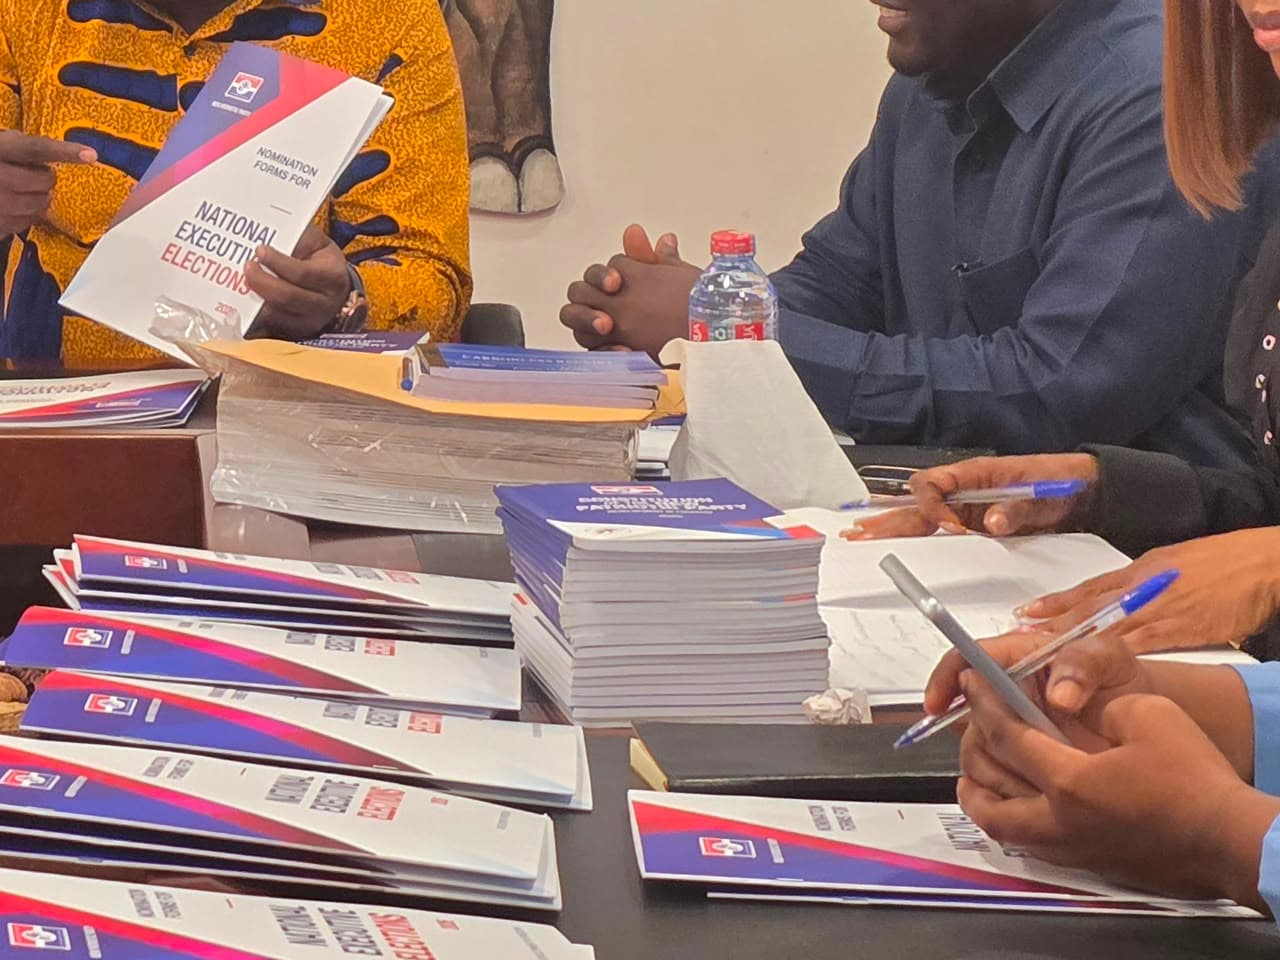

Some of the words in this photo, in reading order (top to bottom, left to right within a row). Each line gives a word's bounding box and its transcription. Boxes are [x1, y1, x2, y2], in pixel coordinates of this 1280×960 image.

[253, 159, 289, 181] FORMS
[288, 173, 312, 190] FOR
[256, 146, 319, 177] NOMINATION
[174, 220, 259, 265] EXECUTIV
[194, 200, 278, 247] NATIONAL
[160, 242, 252, 296] ELECTIONS
